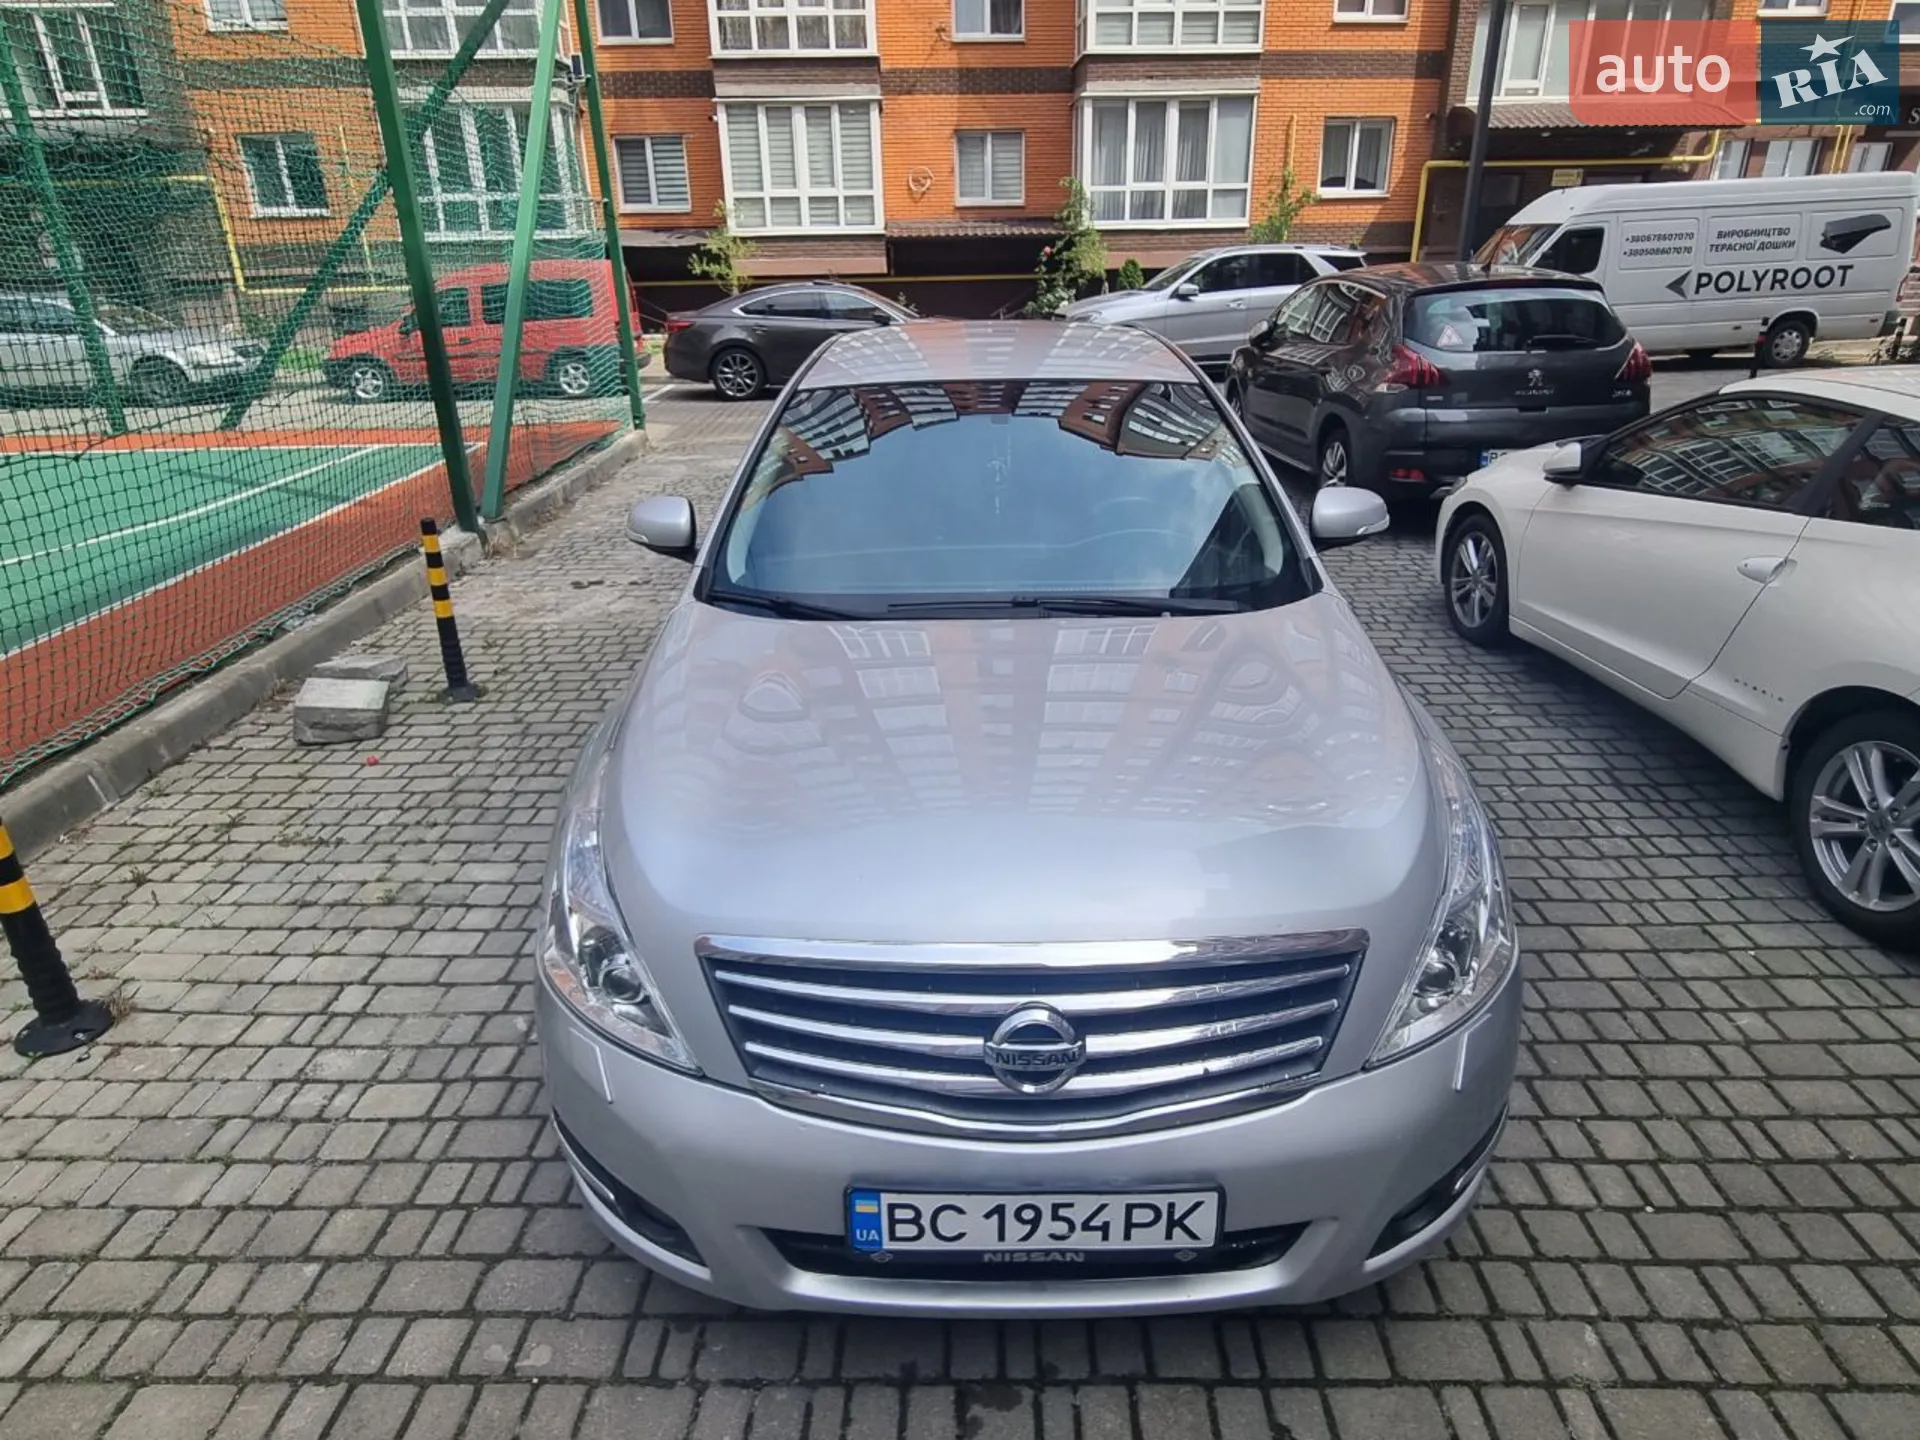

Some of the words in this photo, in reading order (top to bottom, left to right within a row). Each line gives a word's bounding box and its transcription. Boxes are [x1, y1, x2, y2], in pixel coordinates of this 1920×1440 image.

[1716, 227, 1791, 239] ВИРОБНИЦТВО
[1709, 240, 1757, 252] ТЕРАСНОЇ
[1757, 240, 1796, 252] ДОШКИ
[1694, 265, 1854, 295] POLYROOT
[995, 1051, 1077, 1066] NISSAN
[856, 1229, 880, 1241] UA
[983, 1251, 1085, 1262] NISSAN
